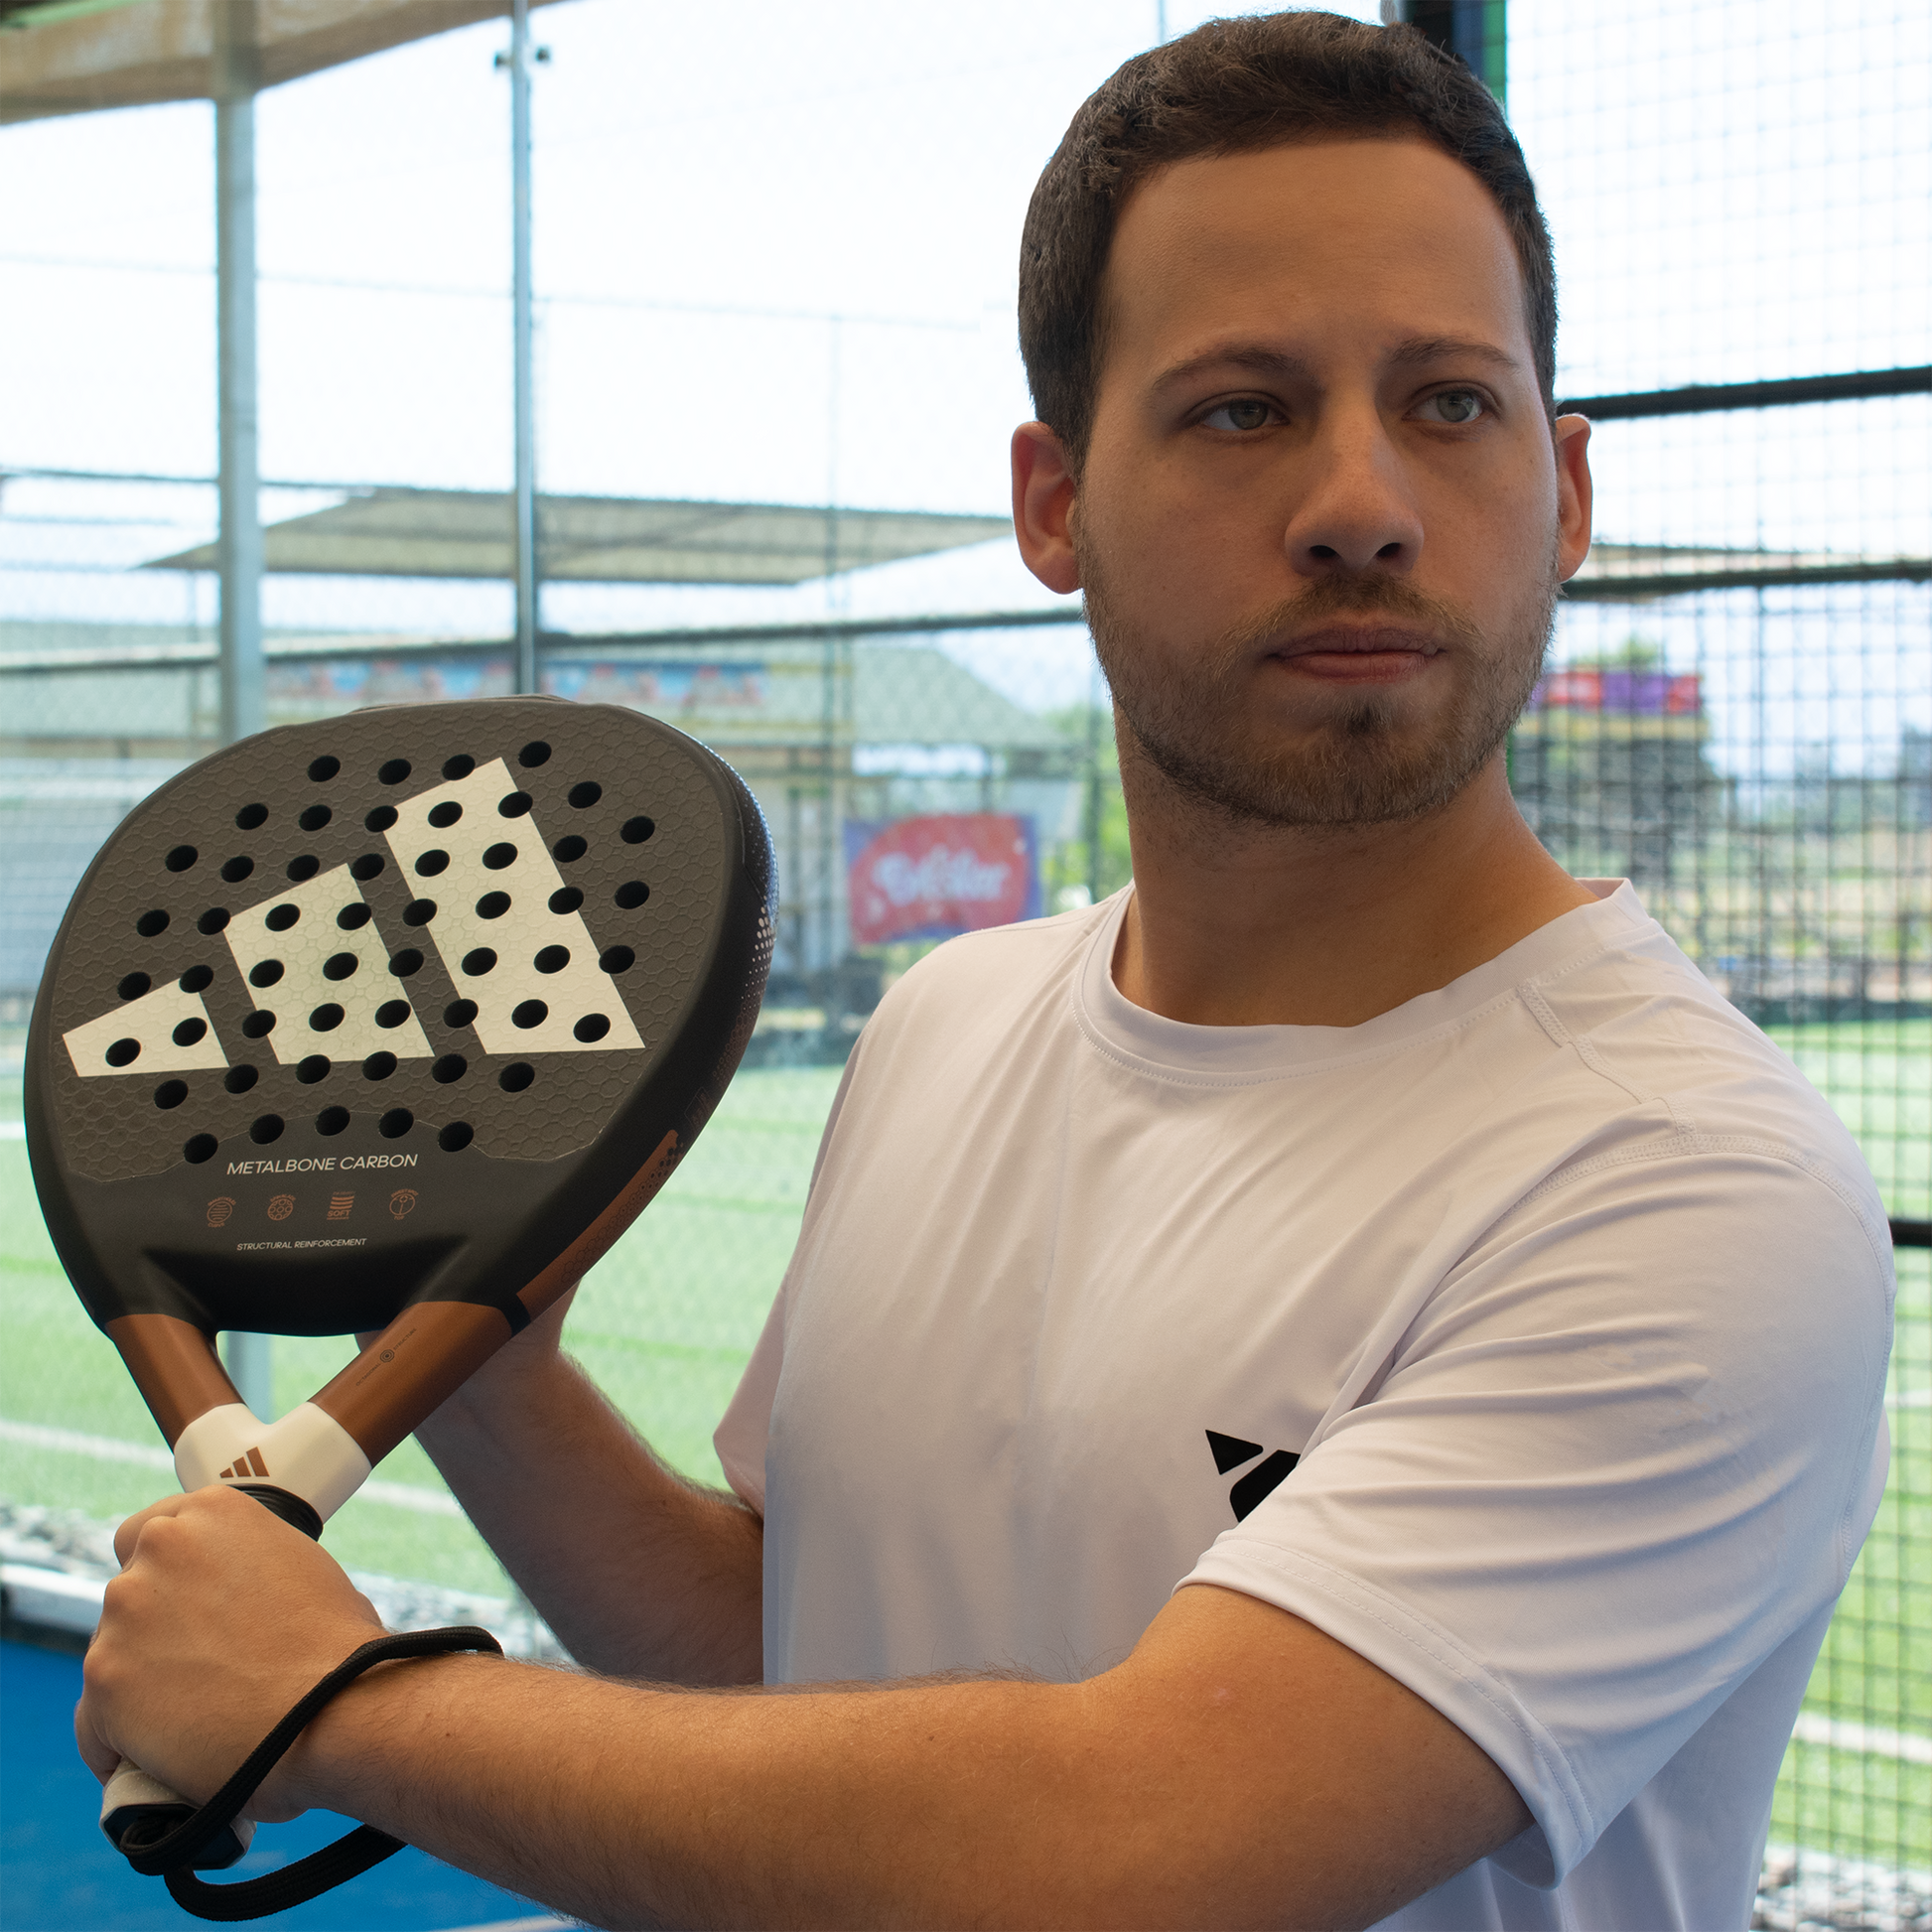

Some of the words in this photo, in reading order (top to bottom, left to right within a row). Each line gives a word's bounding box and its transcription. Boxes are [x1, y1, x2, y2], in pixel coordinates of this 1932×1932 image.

[226, 1157, 337, 1175] METALBONE
[340, 1154, 418, 1171] CARBON
[236, 1241, 293, 1251] STRUCTURAL
[294, 1238, 367, 1249] REINFORCEMENT
